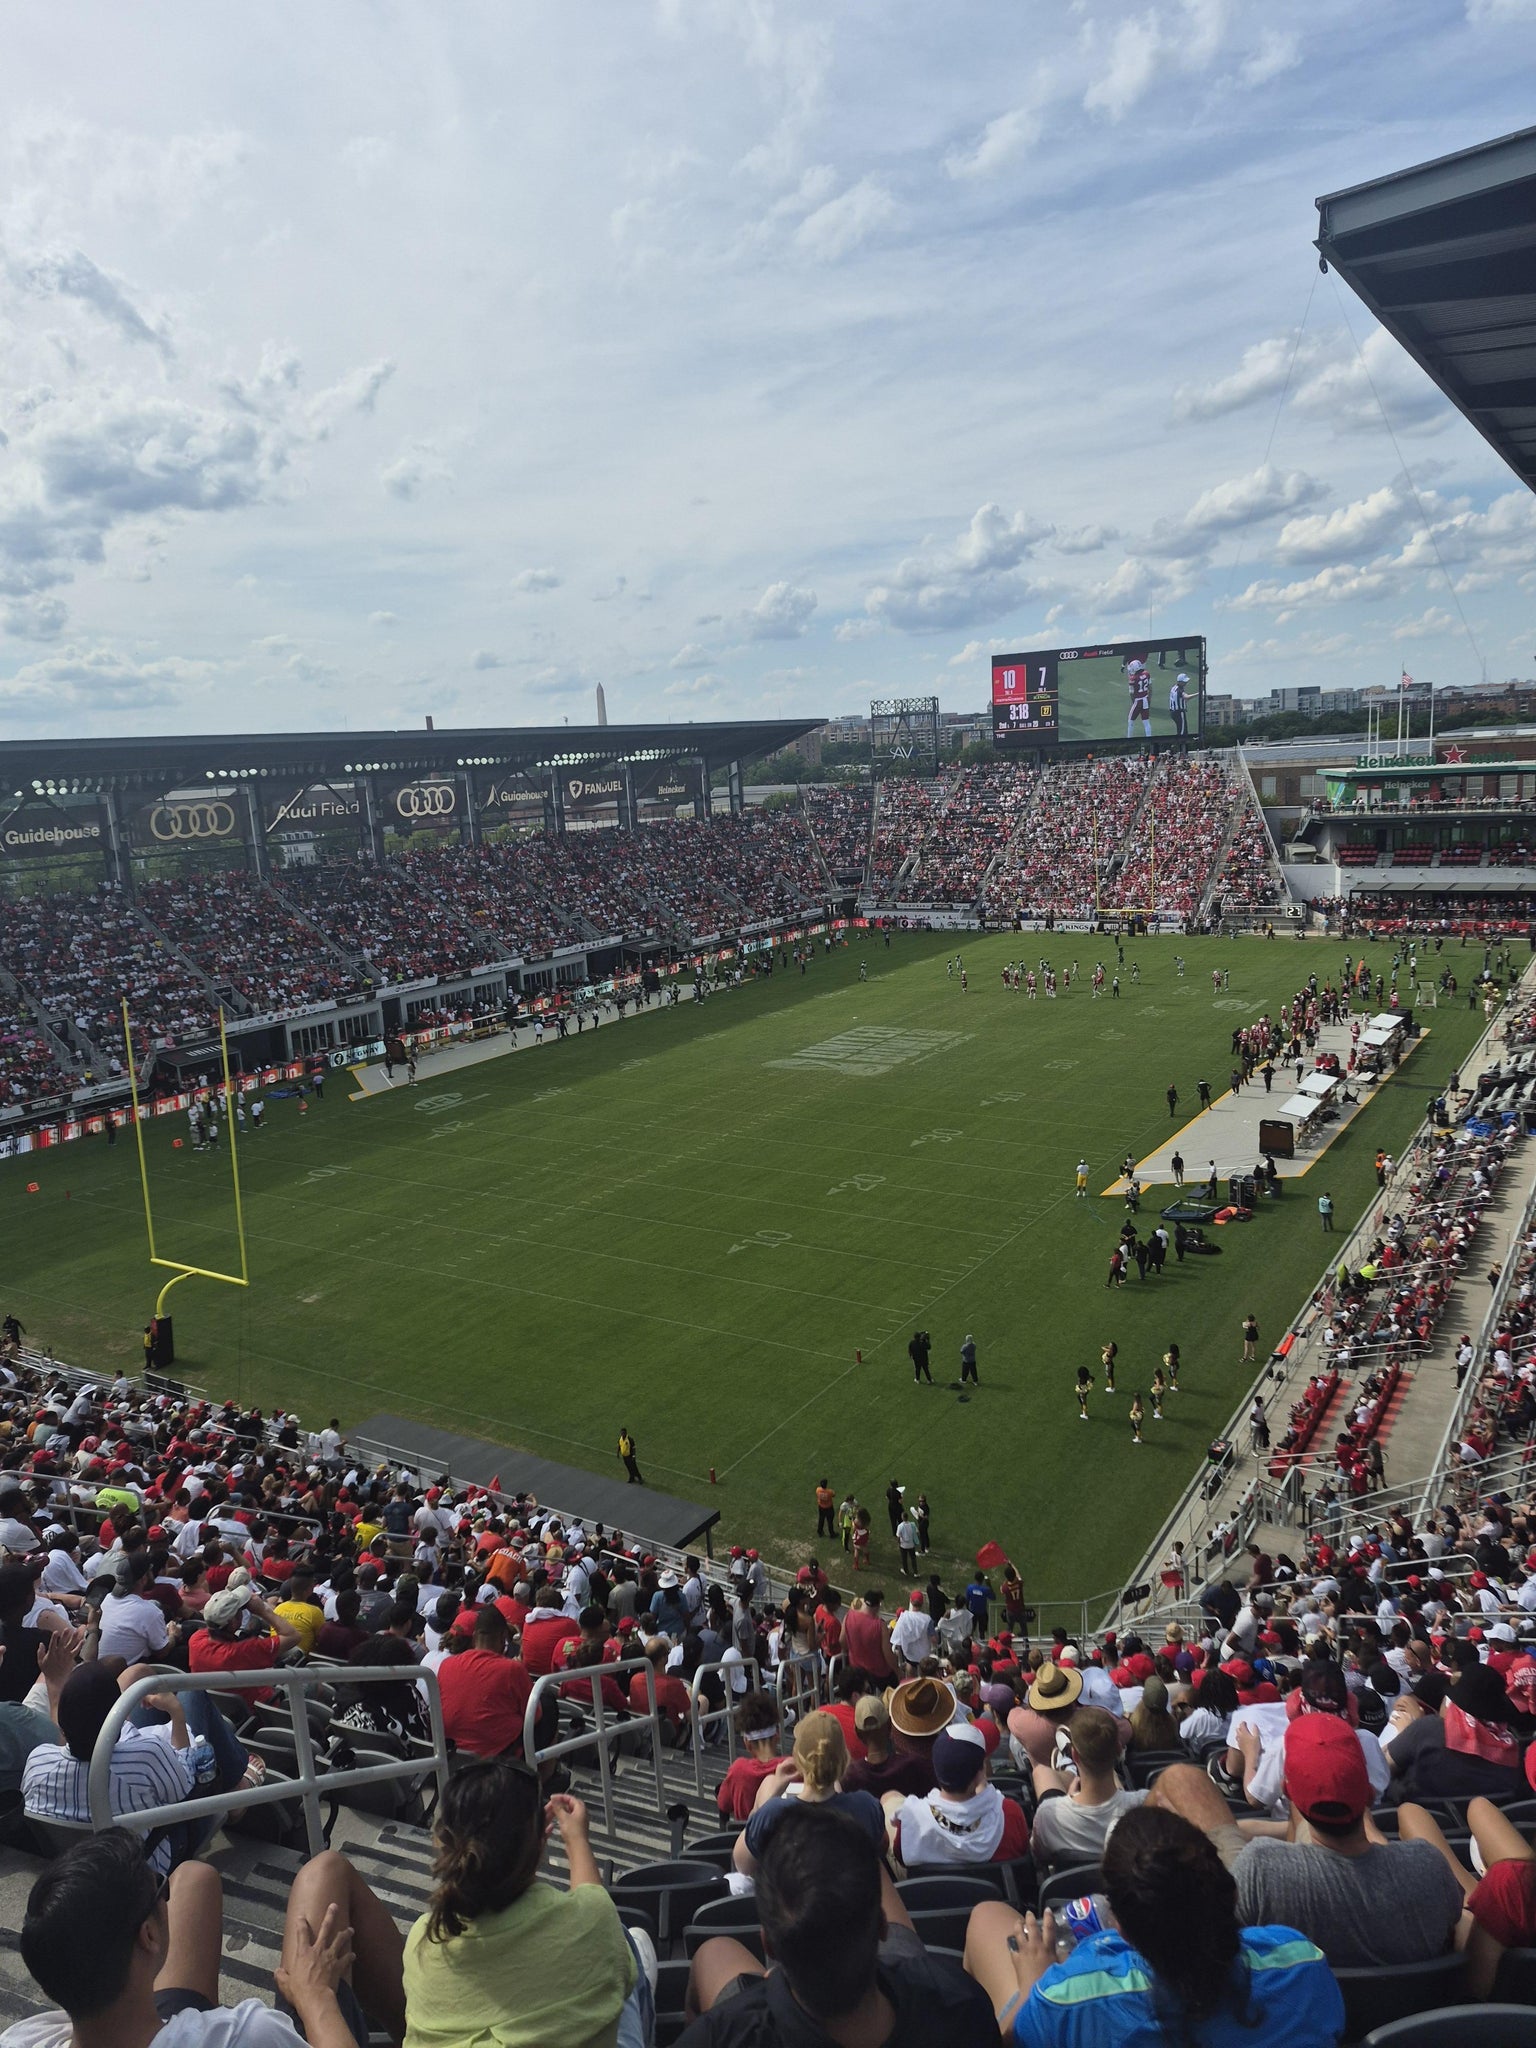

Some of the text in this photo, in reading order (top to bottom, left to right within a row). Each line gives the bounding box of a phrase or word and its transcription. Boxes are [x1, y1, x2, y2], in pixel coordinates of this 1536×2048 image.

[1003, 670, 1016, 689] 10
[1039, 667, 1047, 687] 7
[1009, 703, 1029, 720] 3:18
[1356, 753, 1437, 769] Heineken
[584, 779, 623, 793] FANDUEL
[1384, 780, 1430, 790] Heineken
[501, 787, 549, 803] Guidehouse
[276, 799, 360, 820] Audi Field
[5, 824, 101, 846] Guidehouse
[346, 1046, 379, 1059] SGWAY
[921, 1128, 963, 1143] 30
[839, 1173, 887, 1192] 20
[742, 1229, 793, 1249] 10
